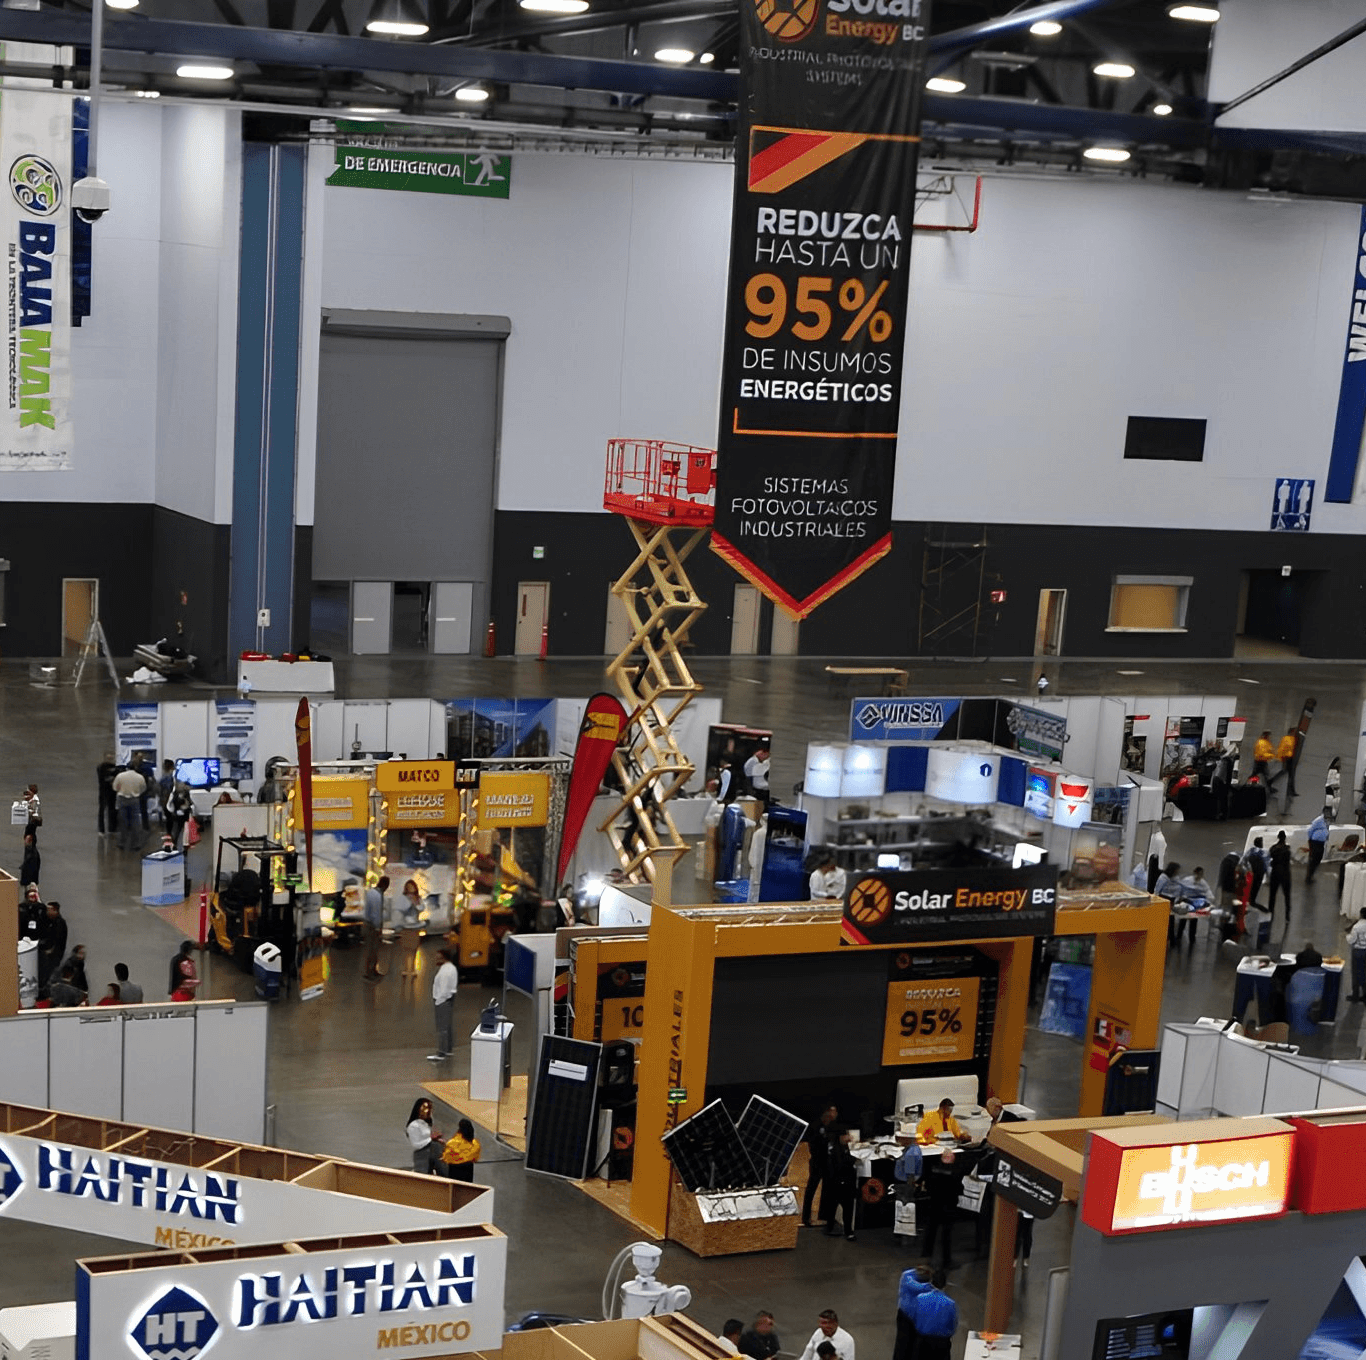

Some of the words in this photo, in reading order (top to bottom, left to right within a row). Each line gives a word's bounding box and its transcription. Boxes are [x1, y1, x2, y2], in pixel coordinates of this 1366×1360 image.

[826, 13, 900, 45] Energy
[902, 25, 925, 42] BC
[344, 155, 365, 171] DE
[367, 157, 461, 178] EMERGENCIA
[756, 207, 902, 241] REDUZCA
[755, 237, 851, 268] HASTA
[860, 243, 899, 270] UN
[744, 272, 894, 343] 95%
[742, 347, 776, 370] DE
[783, 350, 893, 374] INSUMOS
[740, 377, 893, 402] ENERGÉTICOS
[764, 476, 849, 495] SISTEMAS
[731, 497, 878, 517] FOTOVOLTAICOS
[739, 520, 867, 538] INDUSTRIALES
[397, 768, 440, 783] MATCO
[894, 889, 953, 911] Solar
[955, 888, 1028, 911] Energy
[1031, 888, 1055, 904] BC
[899, 1007, 963, 1037] 95%
[37, 1144, 241, 1226] HAITIAN
[145, 1309, 206, 1347] HT
[237, 1251, 479, 1332] HAITIAN
[376, 1318, 472, 1350] MÉXICO
